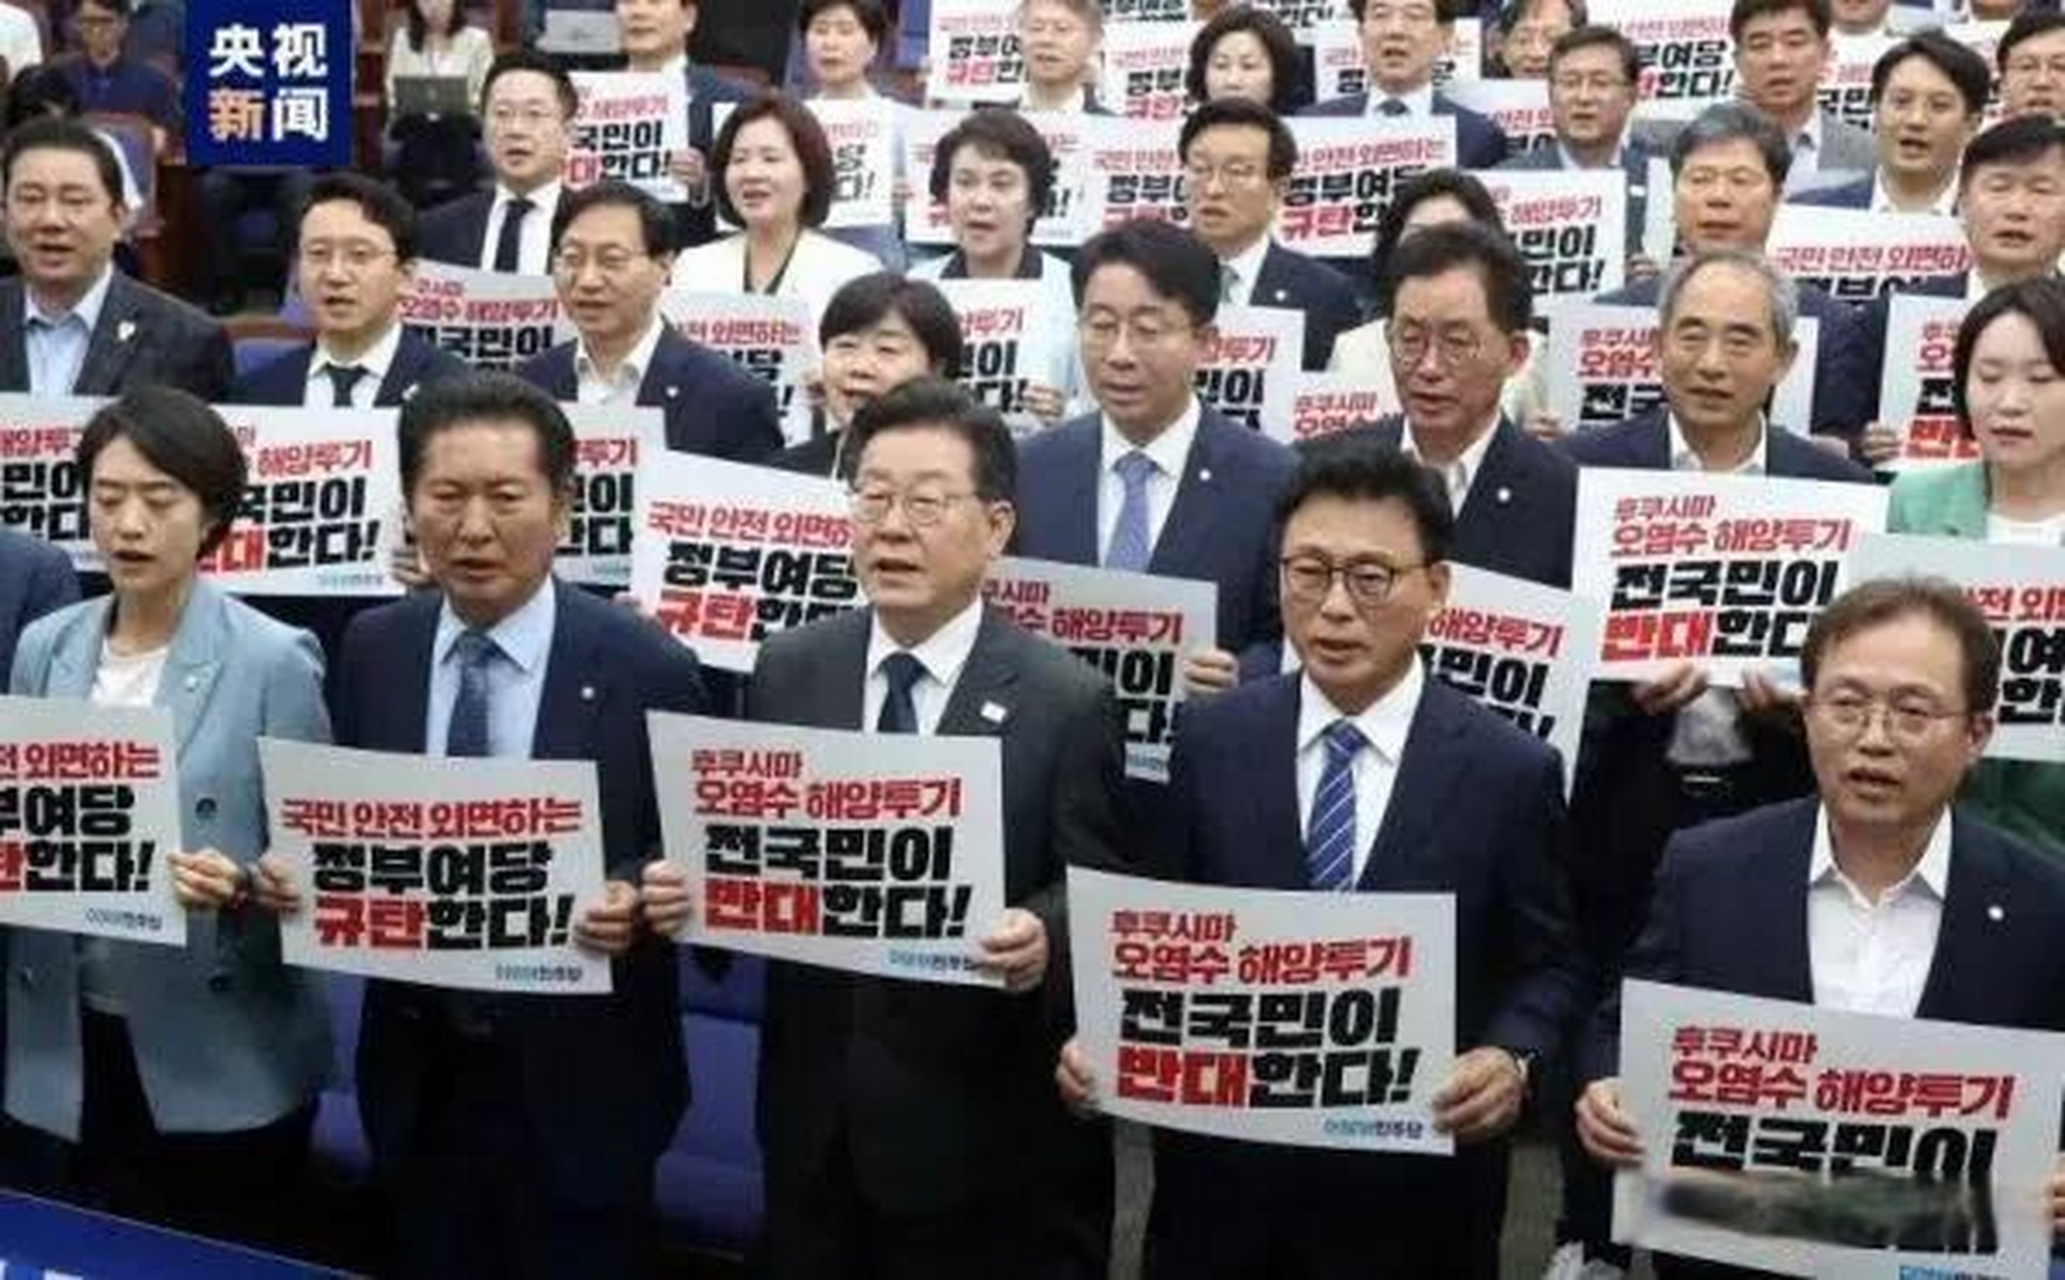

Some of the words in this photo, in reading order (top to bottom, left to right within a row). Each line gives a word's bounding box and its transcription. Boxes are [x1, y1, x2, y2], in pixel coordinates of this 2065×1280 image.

[947, 60, 1030, 84] 규탄한
[1126, 95, 1191, 118] 규탄
[258, 440, 373, 478] 해양투기
[650, 500, 704, 537] 국민
[708, 507, 769, 541] 안전
[1616, 495, 1716, 521] 후쿠시마
[1611, 520, 1708, 558] 오염수
[1714, 518, 1851, 552] 해양투기
[664, 540, 858, 600] 정부여당
[1610, 560, 1840, 612] 전국민이
[2017, 586, 2065, 623] 외
[1051, 607, 1184, 646] 해양투기
[1429, 607, 1563, 659] 해양투기
[25, 741, 160, 780] 외면하는
[691, 749, 804, 779] 후쿠시마
[282, 798, 347, 837] 국민
[353, 801, 424, 840] 안전
[429, 797, 583, 840] 외면하는
[695, 779, 799, 821] 오염수
[805, 777, 962, 821] 해양투기
[312, 841, 555, 896] 정부여당
[704, 824, 954, 883] 전국민이
[314, 893, 577, 951] 규탄한다!
[704, 879, 974, 939] 반대한다!
[1111, 910, 1238, 943] 후쿠시마
[1112, 942, 1230, 985] 오염수
[1238, 936, 1414, 986] 해양투기
[1120, 987, 1401, 1048] 전국민이
[1673, 1025, 1819, 1065] 후쿠시마
[1117, 1046, 1422, 1109] 반대한다!
[1668, 1059, 1807, 1112] 오염수
[1815, 1066, 2016, 1121] 해양투기
